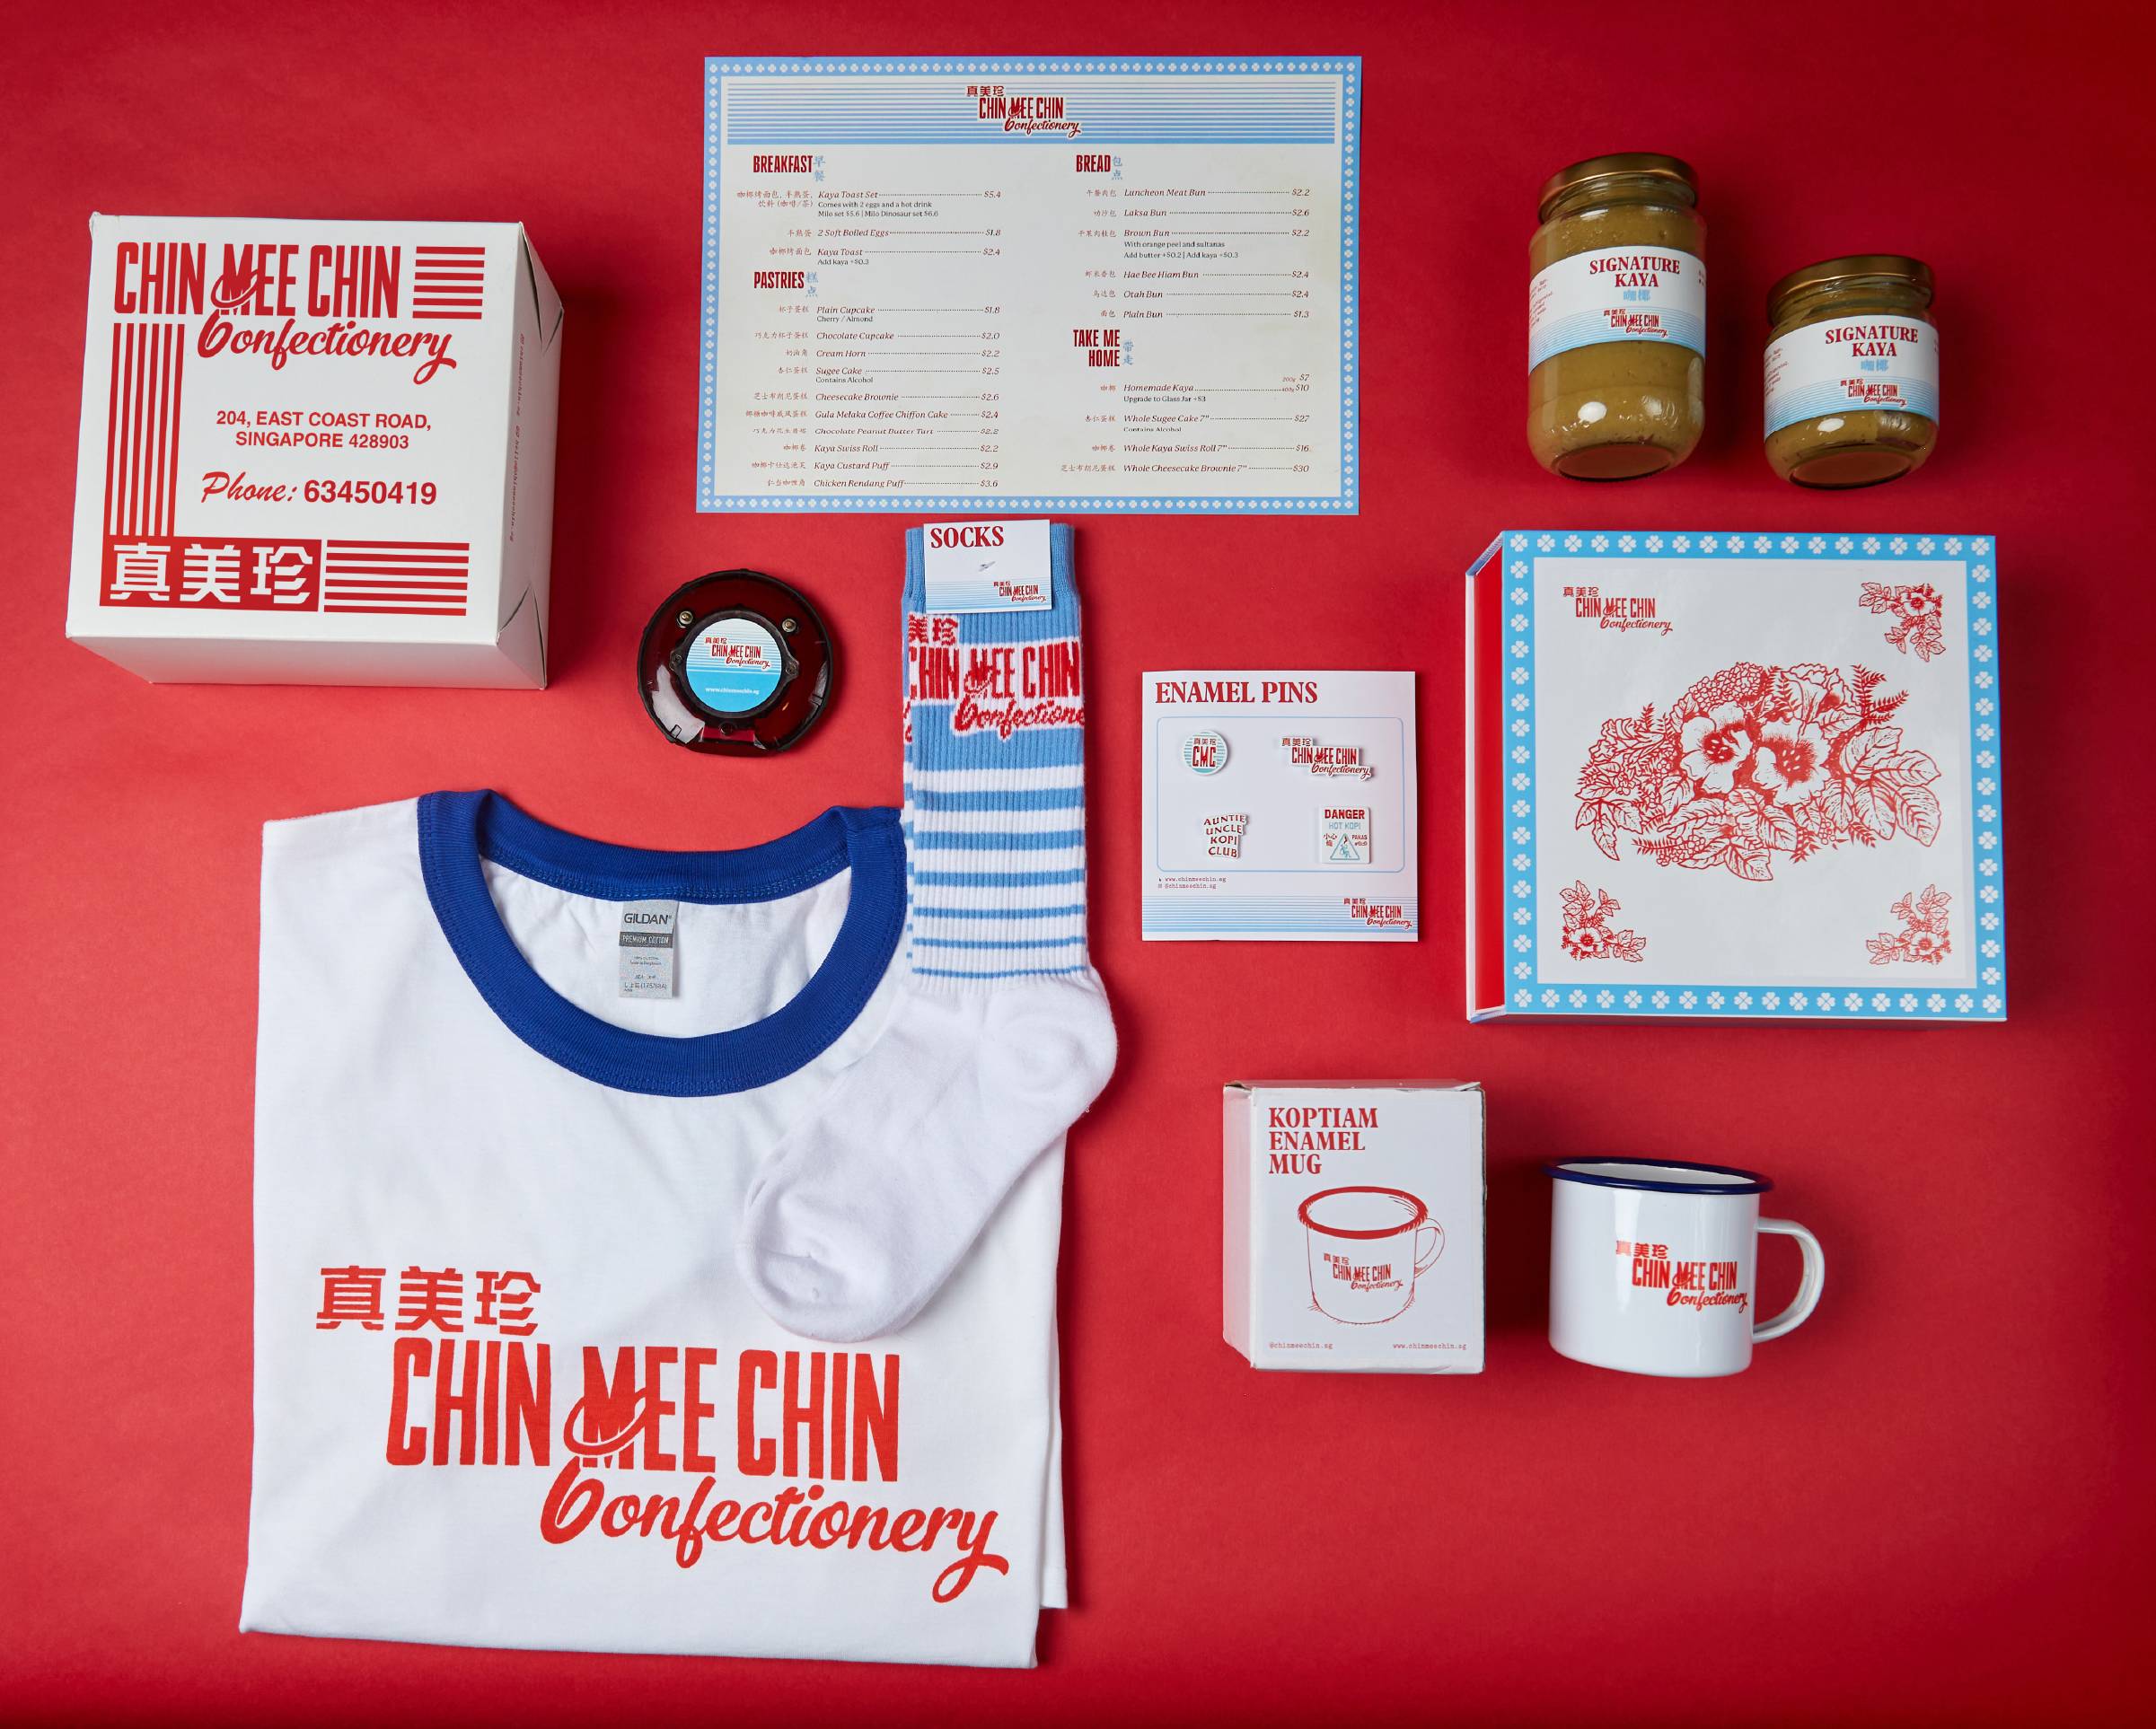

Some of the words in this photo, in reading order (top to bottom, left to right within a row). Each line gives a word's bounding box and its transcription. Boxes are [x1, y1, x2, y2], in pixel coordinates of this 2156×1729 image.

[980, 97, 1006, 118] CHIN
[1008, 97, 1034, 118] MEE
[1036, 97, 1063, 118] CHIN
[1005, 118, 1080, 137] Confectionery
[753, 155, 813, 172] BREAKFAST
[1077, 155, 1111, 172] BREAD
[819, 191, 839, 199] Kaya
[817, 249, 838, 257] Kaya
[1589, 256, 1680, 274] SIGNATURE
[114, 242, 206, 314] CHIN
[211, 243, 299, 316] MEE
[307, 245, 401, 318] CHIN
[754, 272, 805, 288] PASTRIES
[1615, 273, 1659, 287] KAYA
[840, 307, 875, 315] Cupcake
[1073, 329, 1098, 347] TAKE
[1104, 329, 1120, 347] ME
[1826, 325, 1918, 344] SIGNATURE
[198, 309, 457, 384] Confectionery
[981, 349, 1000, 357] $2.2
[1852, 343, 1896, 356] KAYA
[1089, 350, 1120, 366] HOME
[216, 411, 251, 427] 204,
[256, 411, 304, 427] EAST
[308, 412, 370, 428] COAST
[375, 413, 431, 431] ROAD,
[868, 411, 893, 419] Coffee
[895, 411, 925, 419] Chiffon
[235, 432, 344, 449] SINGAPORE
[349, 434, 409, 449] 428903
[814, 445, 835, 453] Kaya
[814, 462, 834, 470] Kaya
[871, 462, 891, 470] Puff
[201, 471, 298, 505] Phone:
[304, 479, 436, 505] 63450419
[886, 480, 904, 488] Puff
[930, 526, 1004, 548] SOCKS
[110, 542, 314, 604] 真美珍
[1576, 598, 1601, 618] CHIN
[1603, 598, 1627, 618] MEE
[1630, 598, 1655, 618] CHIN
[1600, 616, 1673, 636] Confectionery
[712, 645, 727, 656] CHIN
[745, 646, 761, 658] CHIN
[964, 645, 1016, 699] MEE
[1022, 641, 1080, 698] CHIN
[1156, 682, 1254, 703] ENAMEL
[1262, 682, 1318, 703] PINS
[1192, 746, 1216, 767] CMC
[1292, 747, 1313, 763] CHIN
[1315, 748, 1333, 764] MEE
[1336, 748, 1356, 764] CHIN
[1312, 763, 1369, 779] Confectionery
[1204, 815, 1245, 825] AUNTIE
[1324, 810, 1365, 819] DANGER
[1207, 825, 1242, 835] UNCLE
[1210, 836, 1236, 845] KOPI
[1209, 847, 1236, 857] CLUB
[624, 913, 668, 925] GILDAN
[1351, 905, 1368, 917] CHIN
[1368, 906, 1384, 917] MEE
[1386, 906, 1401, 917] CHIN
[1269, 1108, 1378, 1128] KOPTIAM
[1269, 1132, 1365, 1151] ENAMEL
[1269, 1154, 1322, 1174] MUG
[1333, 1264, 1351, 1281] CHIN
[1372, 1264, 1391, 1281] CHIN
[1632, 1259, 1670, 1288] CHIN
[1672, 1261, 1706, 1290] MEE
[1709, 1261, 1738, 1290] CHIN
[315, 1265, 541, 1336] 真美珍
[1667, 1287, 1747, 1313] Confectionery
[386, 1338, 551, 1467] CHIN
[563, 1346, 717, 1473] MEE
[737, 1349, 899, 1482] CHIN
[540, 1456, 1008, 1602] Confectionery
